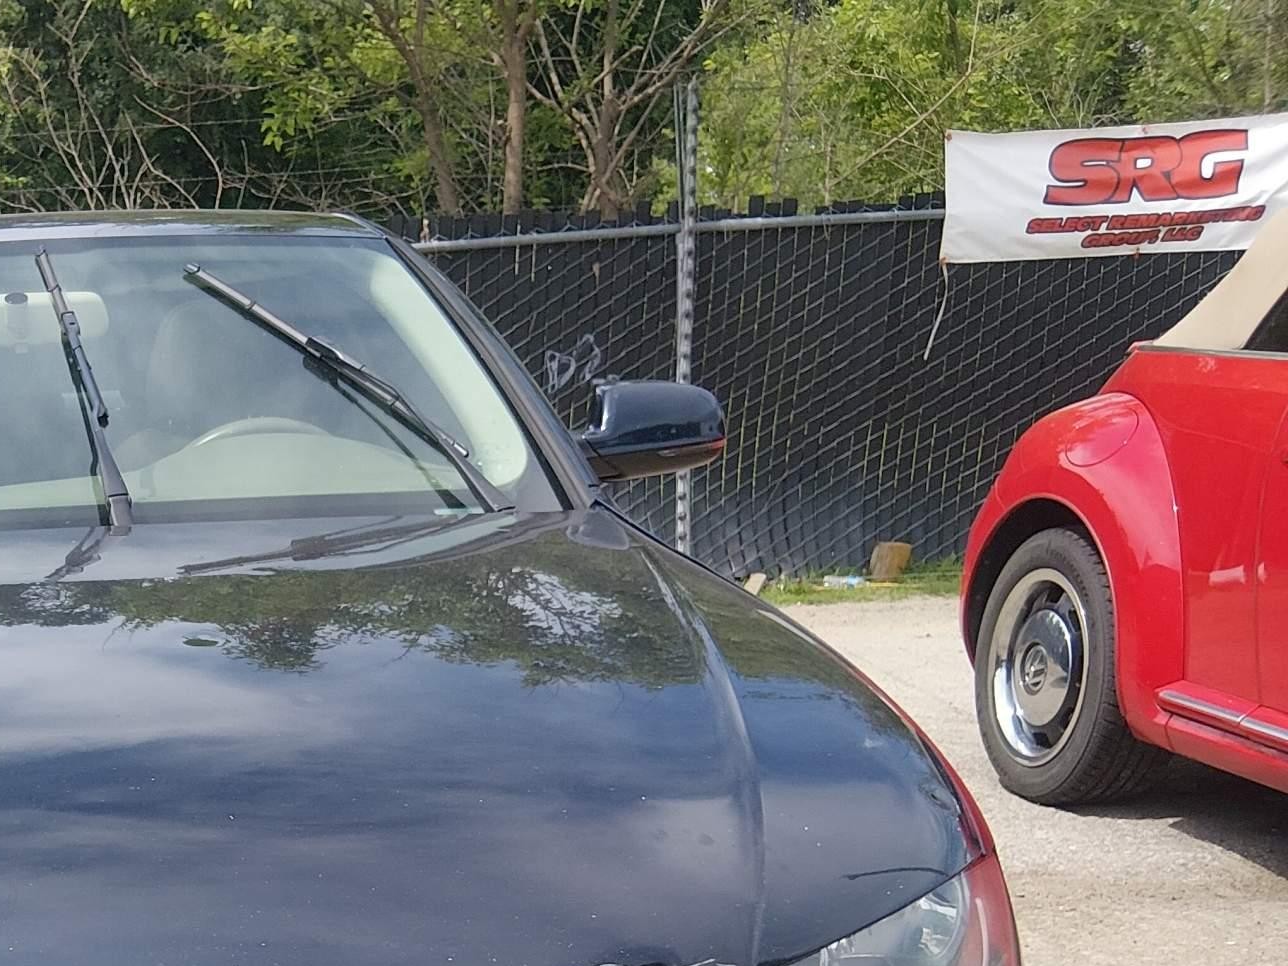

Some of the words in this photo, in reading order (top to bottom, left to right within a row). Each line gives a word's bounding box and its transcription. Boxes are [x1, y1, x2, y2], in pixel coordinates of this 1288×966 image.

[1042, 128, 1249, 206] SRG
[1026, 215, 1109, 233] SELECT
[1107, 205, 1265, 230] REMARKETING
[1162, 226, 1204, 242] LLC
